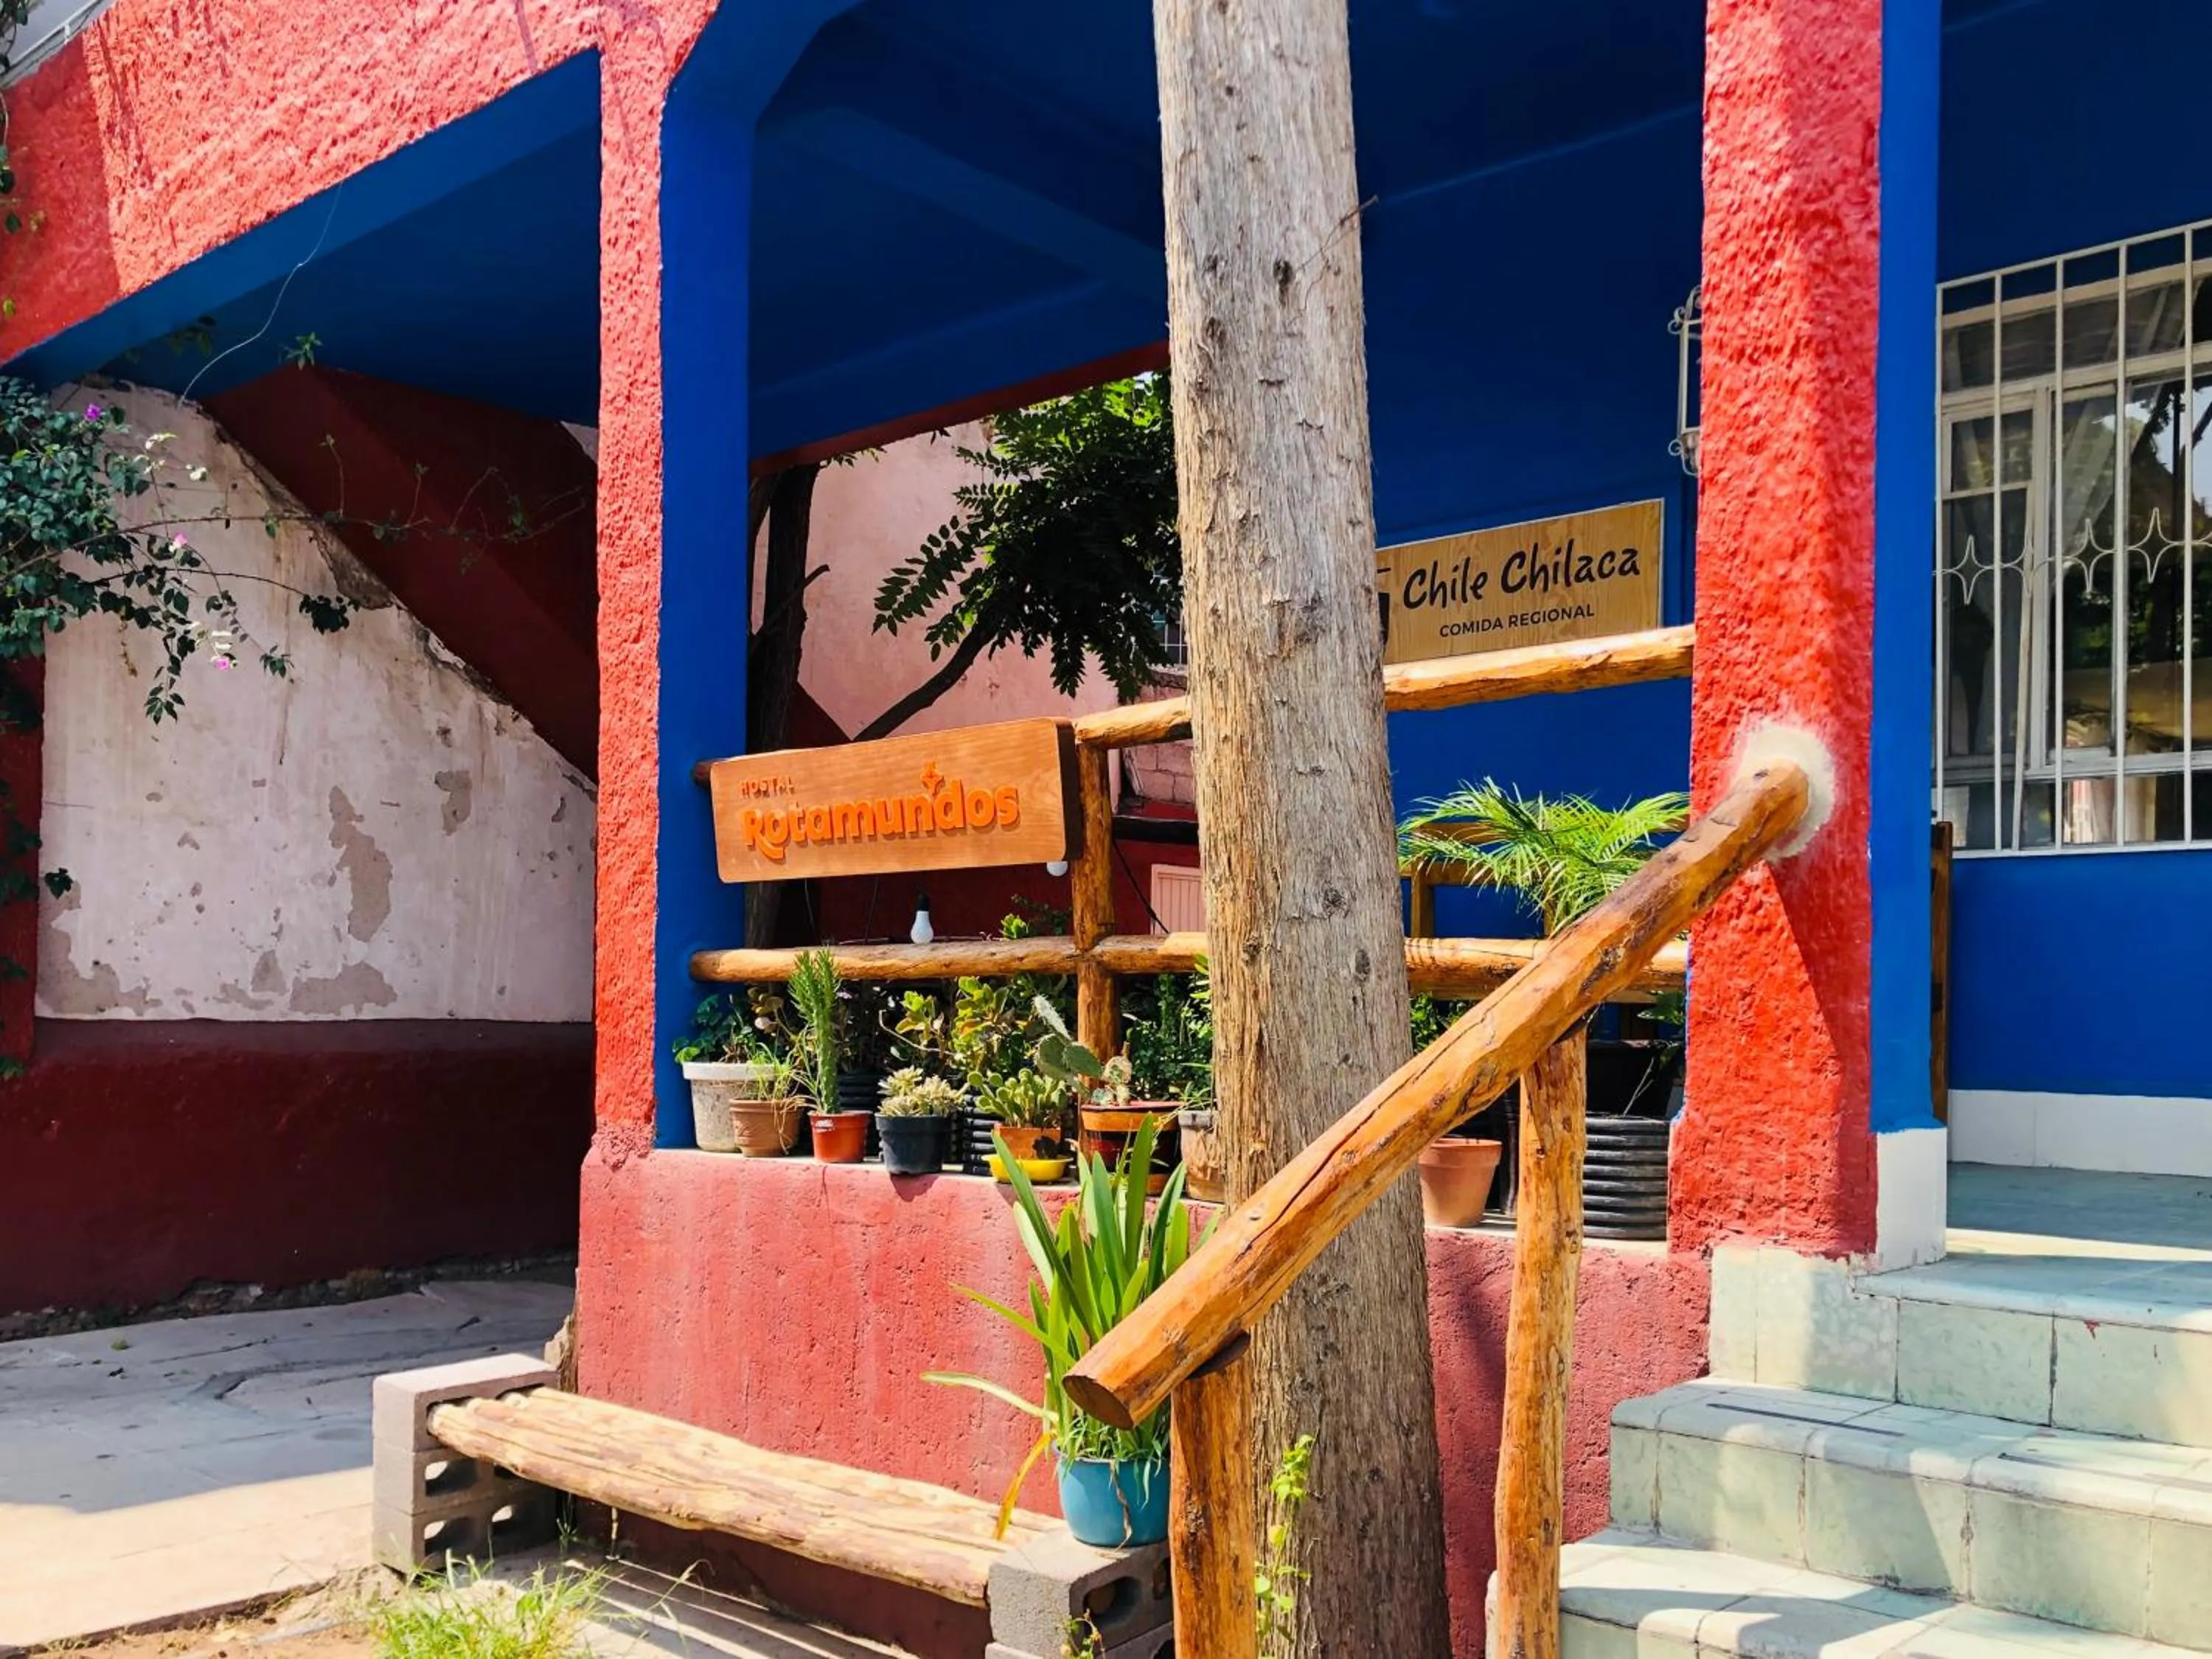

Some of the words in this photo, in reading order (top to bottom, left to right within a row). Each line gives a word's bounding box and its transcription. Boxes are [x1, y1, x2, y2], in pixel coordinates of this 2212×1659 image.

[1403, 556, 1489, 610] Chile
[1500, 538, 1641, 594] Chilaca
[1439, 617, 1504, 638] COMIDA
[1508, 603, 1596, 629] REGIONAL
[740, 776, 796, 799] HOSTAL
[744, 778, 1020, 860] Rotamundos
